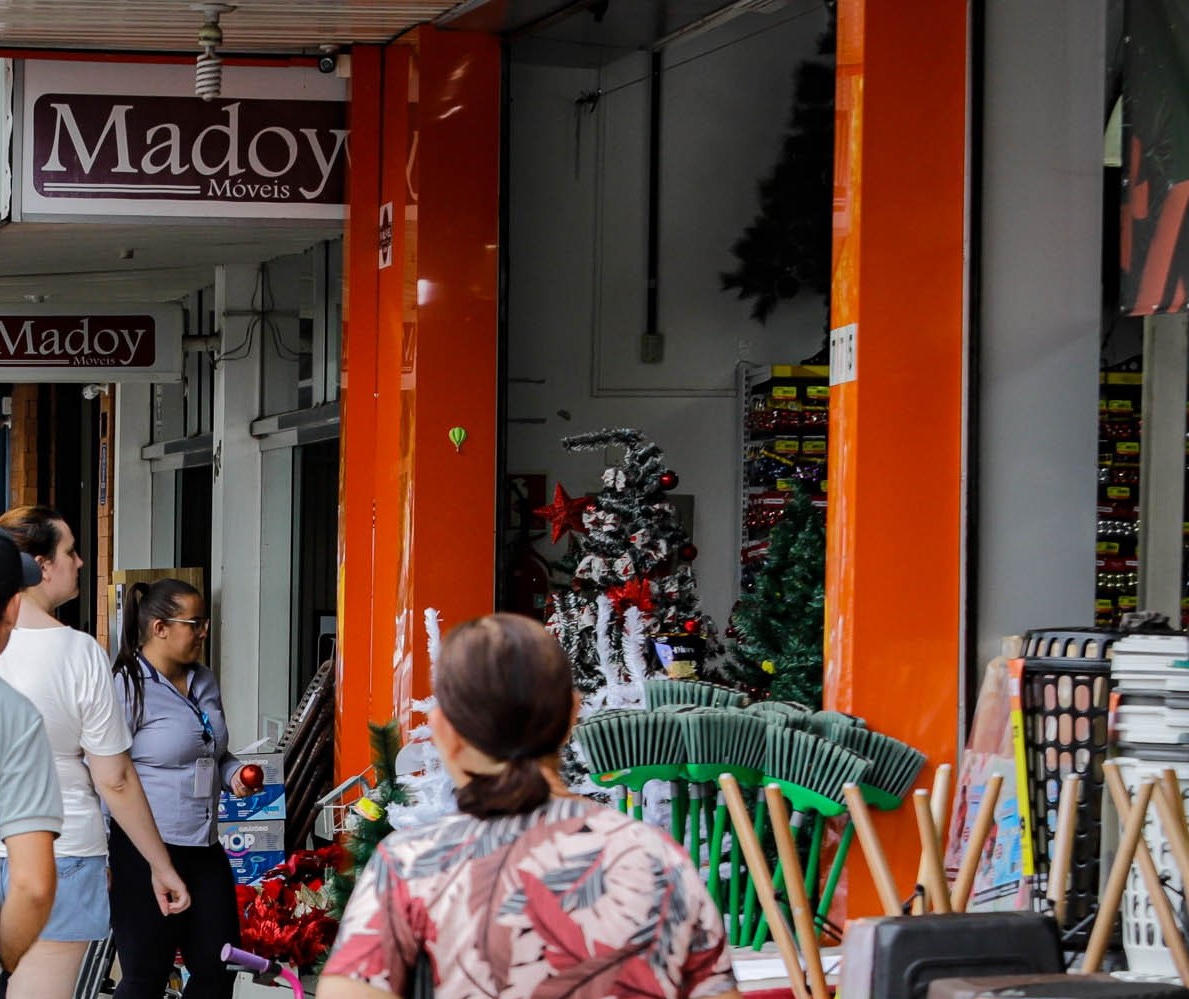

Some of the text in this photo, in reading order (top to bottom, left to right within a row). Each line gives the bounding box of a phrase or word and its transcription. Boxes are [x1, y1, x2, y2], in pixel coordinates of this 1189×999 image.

[41, 101, 351, 200] Madoy
[207, 178, 290, 199] Móveis
[73, 355, 116, 367] Móveis
[218, 833, 256, 852] MOP
